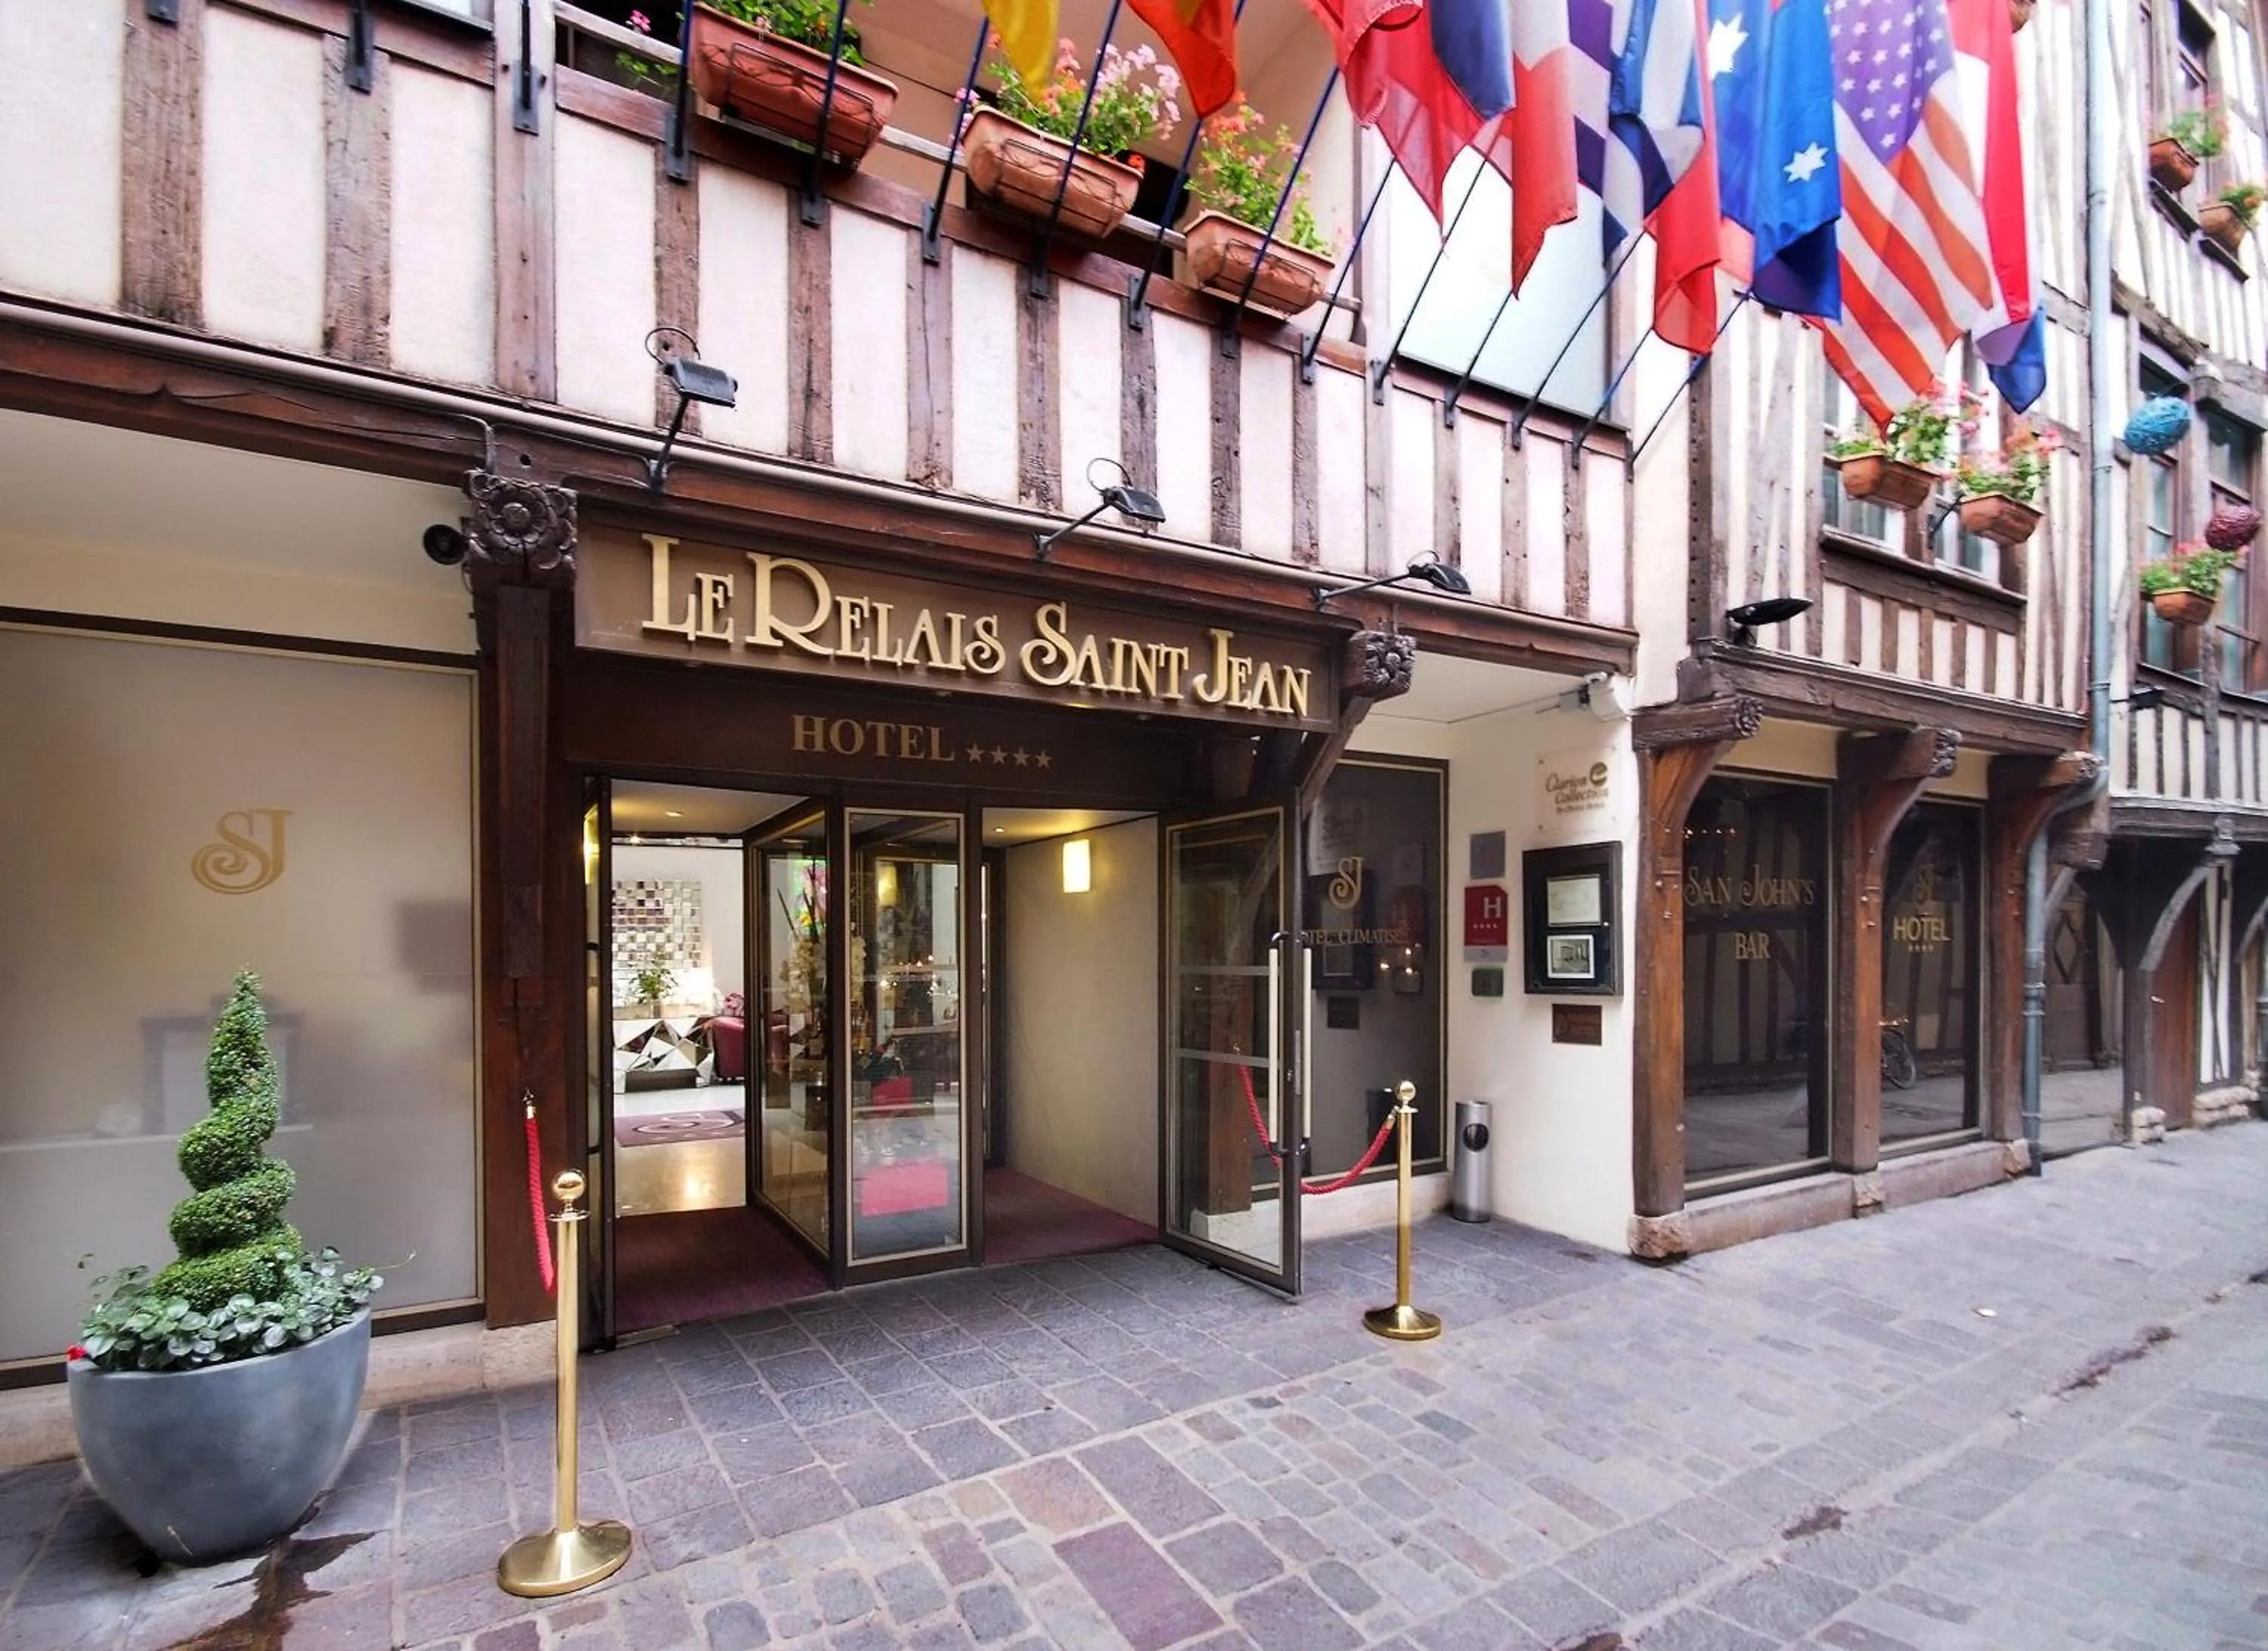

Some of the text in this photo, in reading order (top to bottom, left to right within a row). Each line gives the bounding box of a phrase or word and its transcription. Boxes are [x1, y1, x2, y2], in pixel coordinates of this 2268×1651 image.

[642, 533, 1312, 717] LE RELAIS SAINT JEAN
[790, 714, 955, 762] HOTEL
[1483, 897, 1503, 919] H
[1894, 916, 1952, 942] HOTEL
[1735, 932, 1771, 960] BAR
